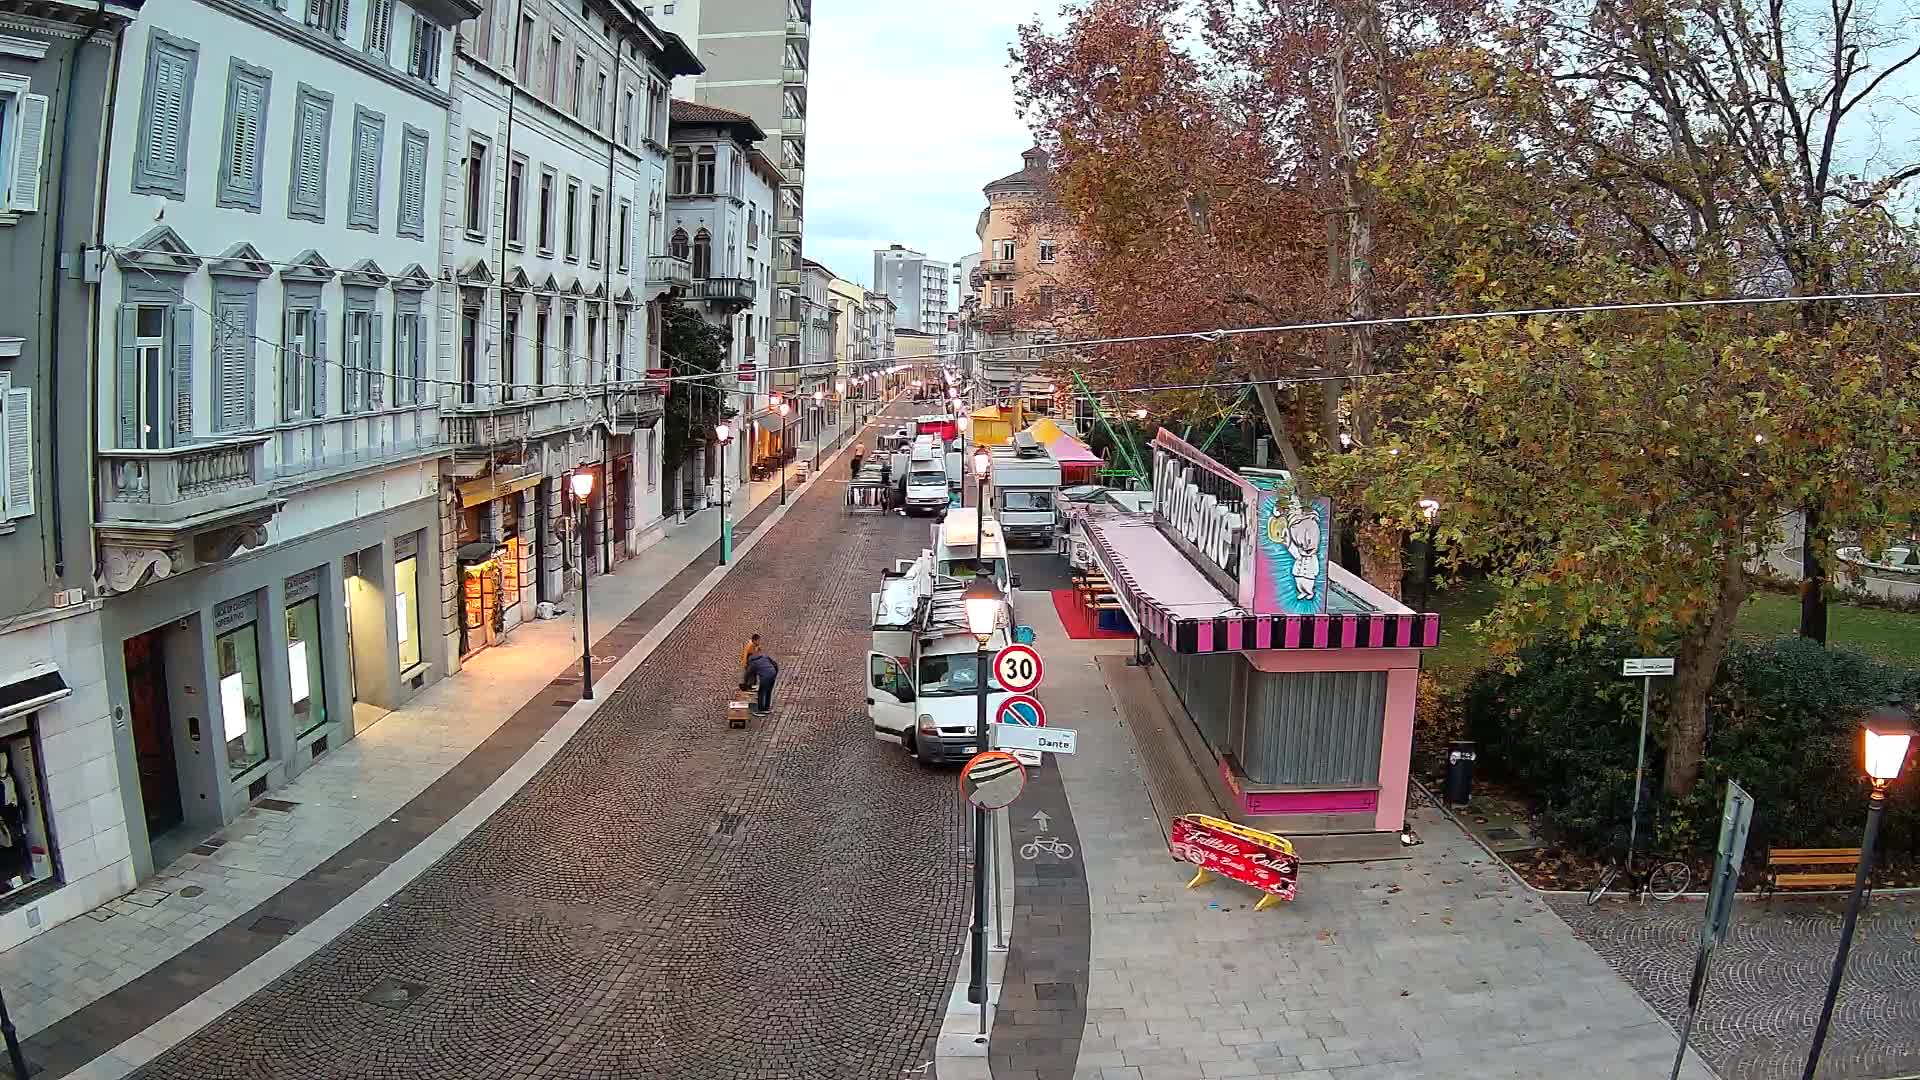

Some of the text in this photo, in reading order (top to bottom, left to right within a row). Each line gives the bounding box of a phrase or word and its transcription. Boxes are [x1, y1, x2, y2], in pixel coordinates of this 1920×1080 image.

[1163, 459, 1236, 569] Golosone
[1006, 658, 1032, 680] 30
[1038, 737, 1070, 749] Dante
[1244, 853, 1291, 874] Calde
